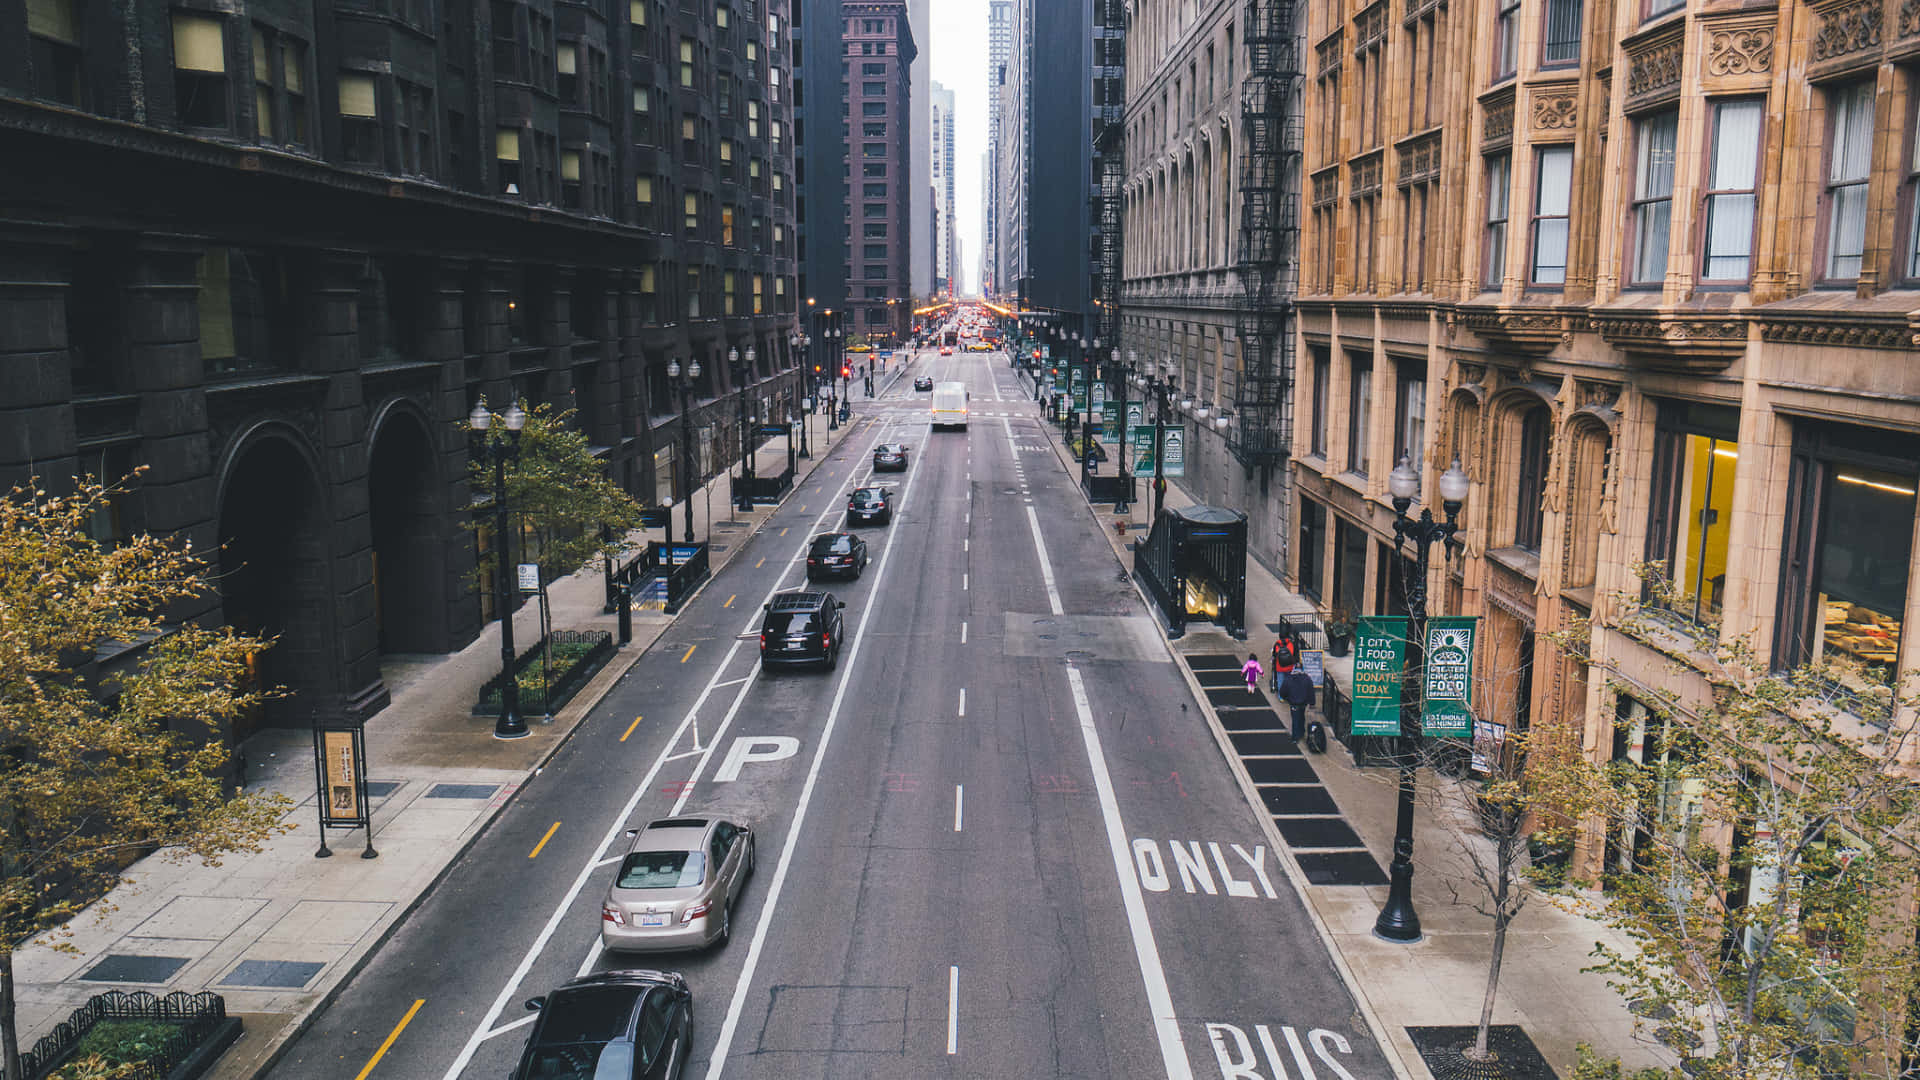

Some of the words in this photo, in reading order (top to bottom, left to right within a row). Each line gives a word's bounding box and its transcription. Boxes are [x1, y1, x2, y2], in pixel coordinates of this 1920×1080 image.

[1359, 636, 1365, 647] 1
[1357, 647, 1363, 658] 1
[1366, 649, 1395, 660] FOOD
[1356, 672, 1398, 682] DONATE
[1429, 680, 1464, 692] FOOD
[712, 735, 800, 783] P
[1132, 838, 1278, 899] ONLY
[1206, 1022, 1354, 1080] BUS
